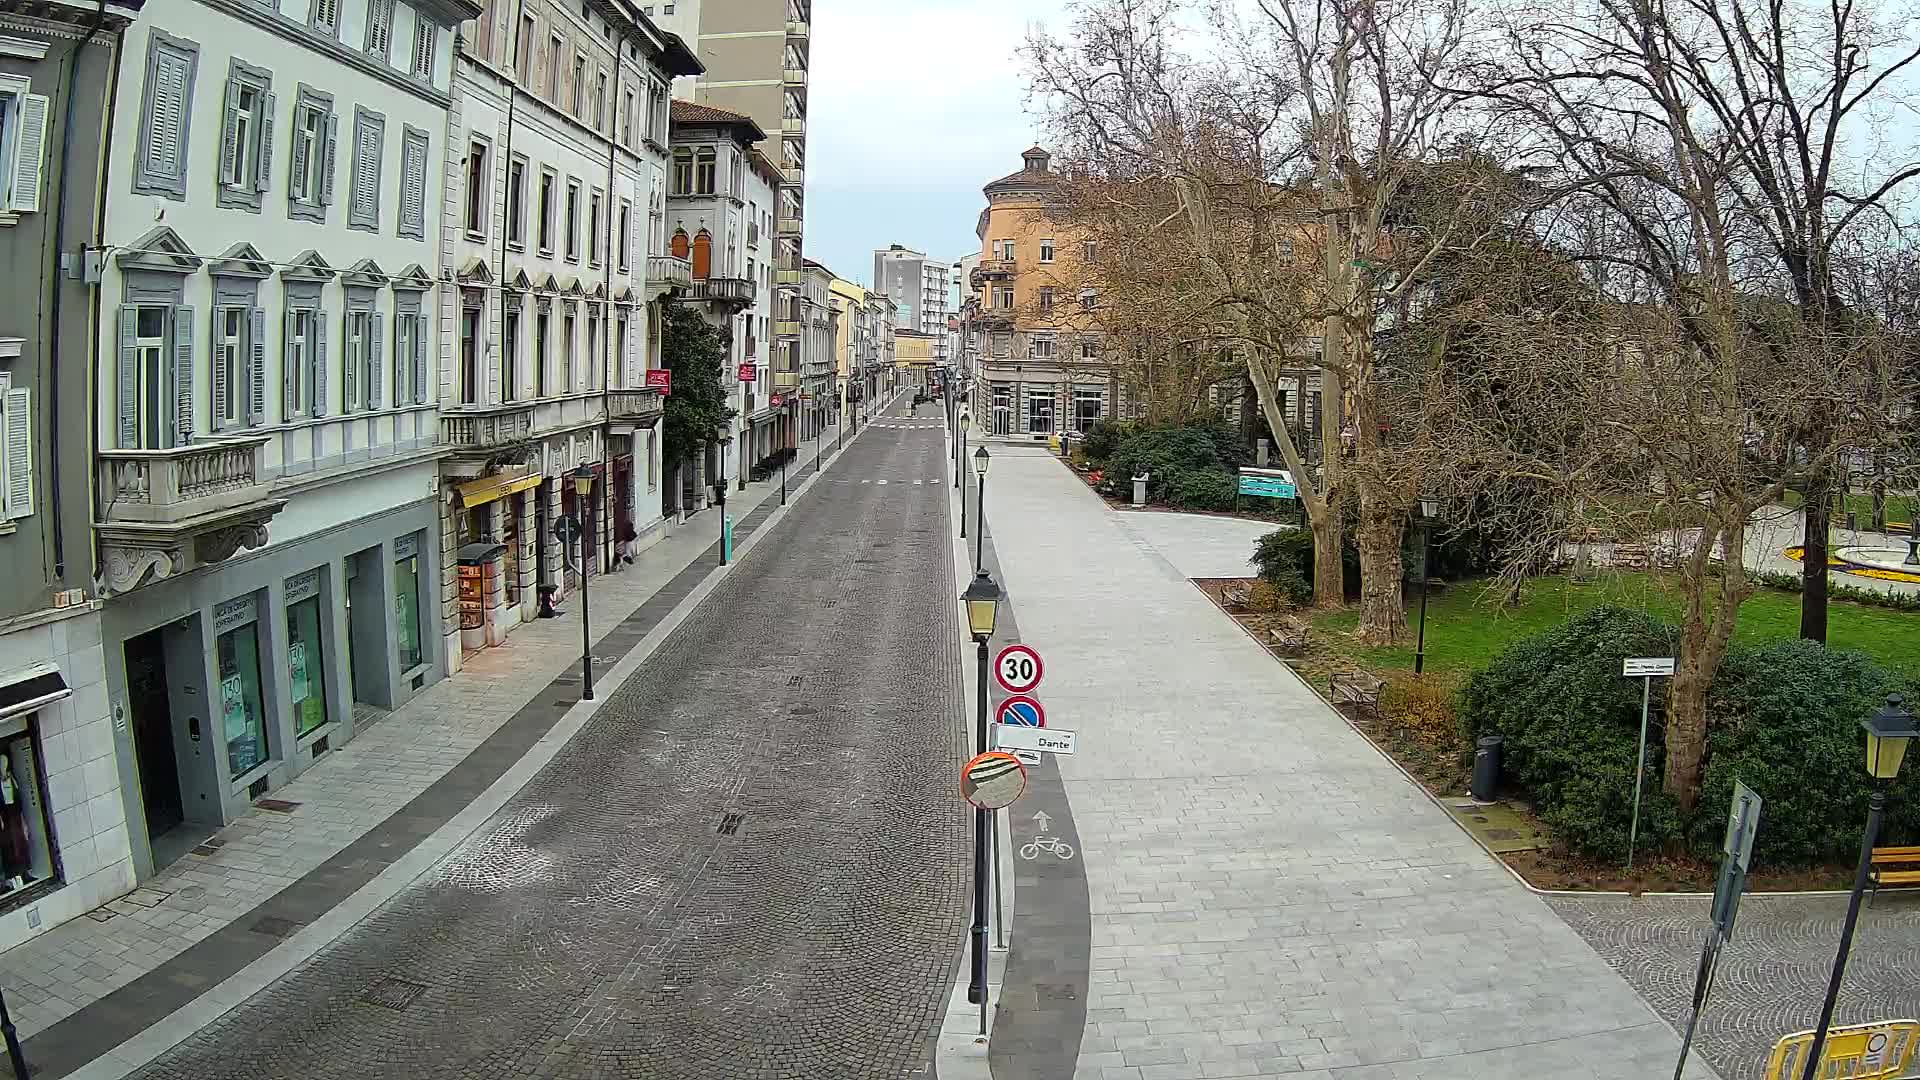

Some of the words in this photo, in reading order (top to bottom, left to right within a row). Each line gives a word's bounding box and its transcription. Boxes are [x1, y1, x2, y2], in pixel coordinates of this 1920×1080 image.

[1005, 658, 1033, 681] 30
[222, 677, 241, 700] 130
[1038, 738, 1070, 749] Dante
